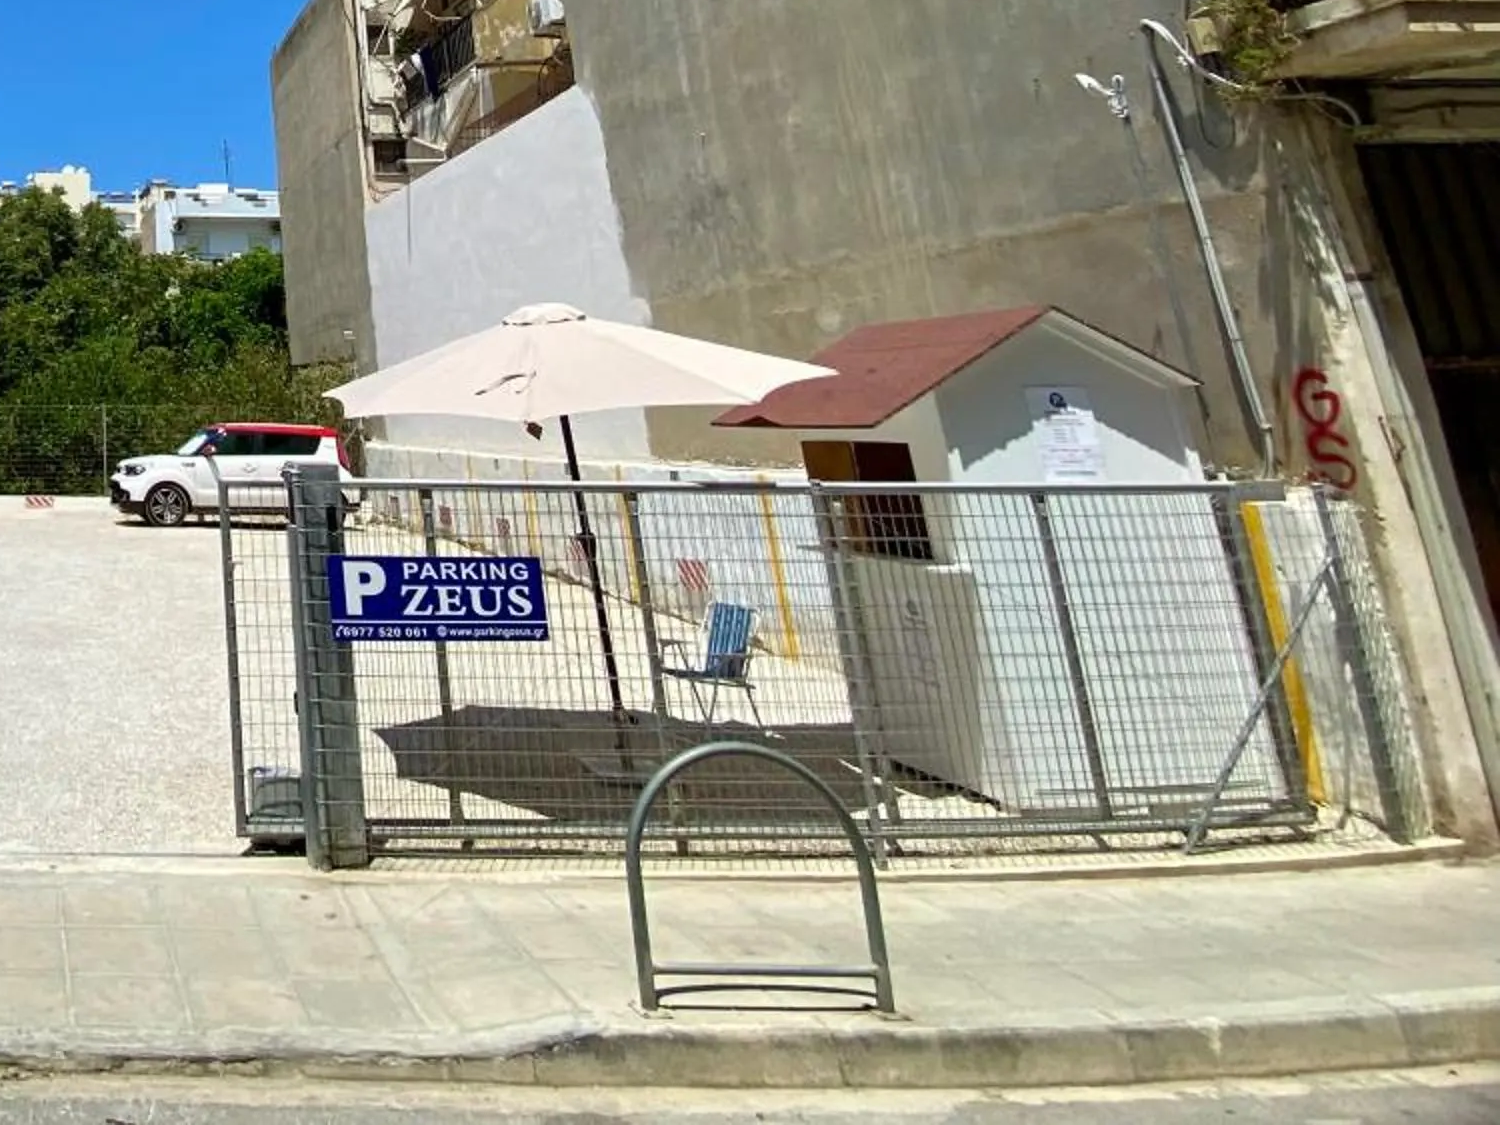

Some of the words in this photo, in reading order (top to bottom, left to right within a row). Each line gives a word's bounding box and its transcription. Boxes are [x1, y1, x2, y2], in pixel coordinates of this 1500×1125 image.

[402, 562, 529, 580] PARKING
[342, 560, 387, 616] P
[400, 584, 534, 617] ZEUS
[379, 626, 402, 638] 520
